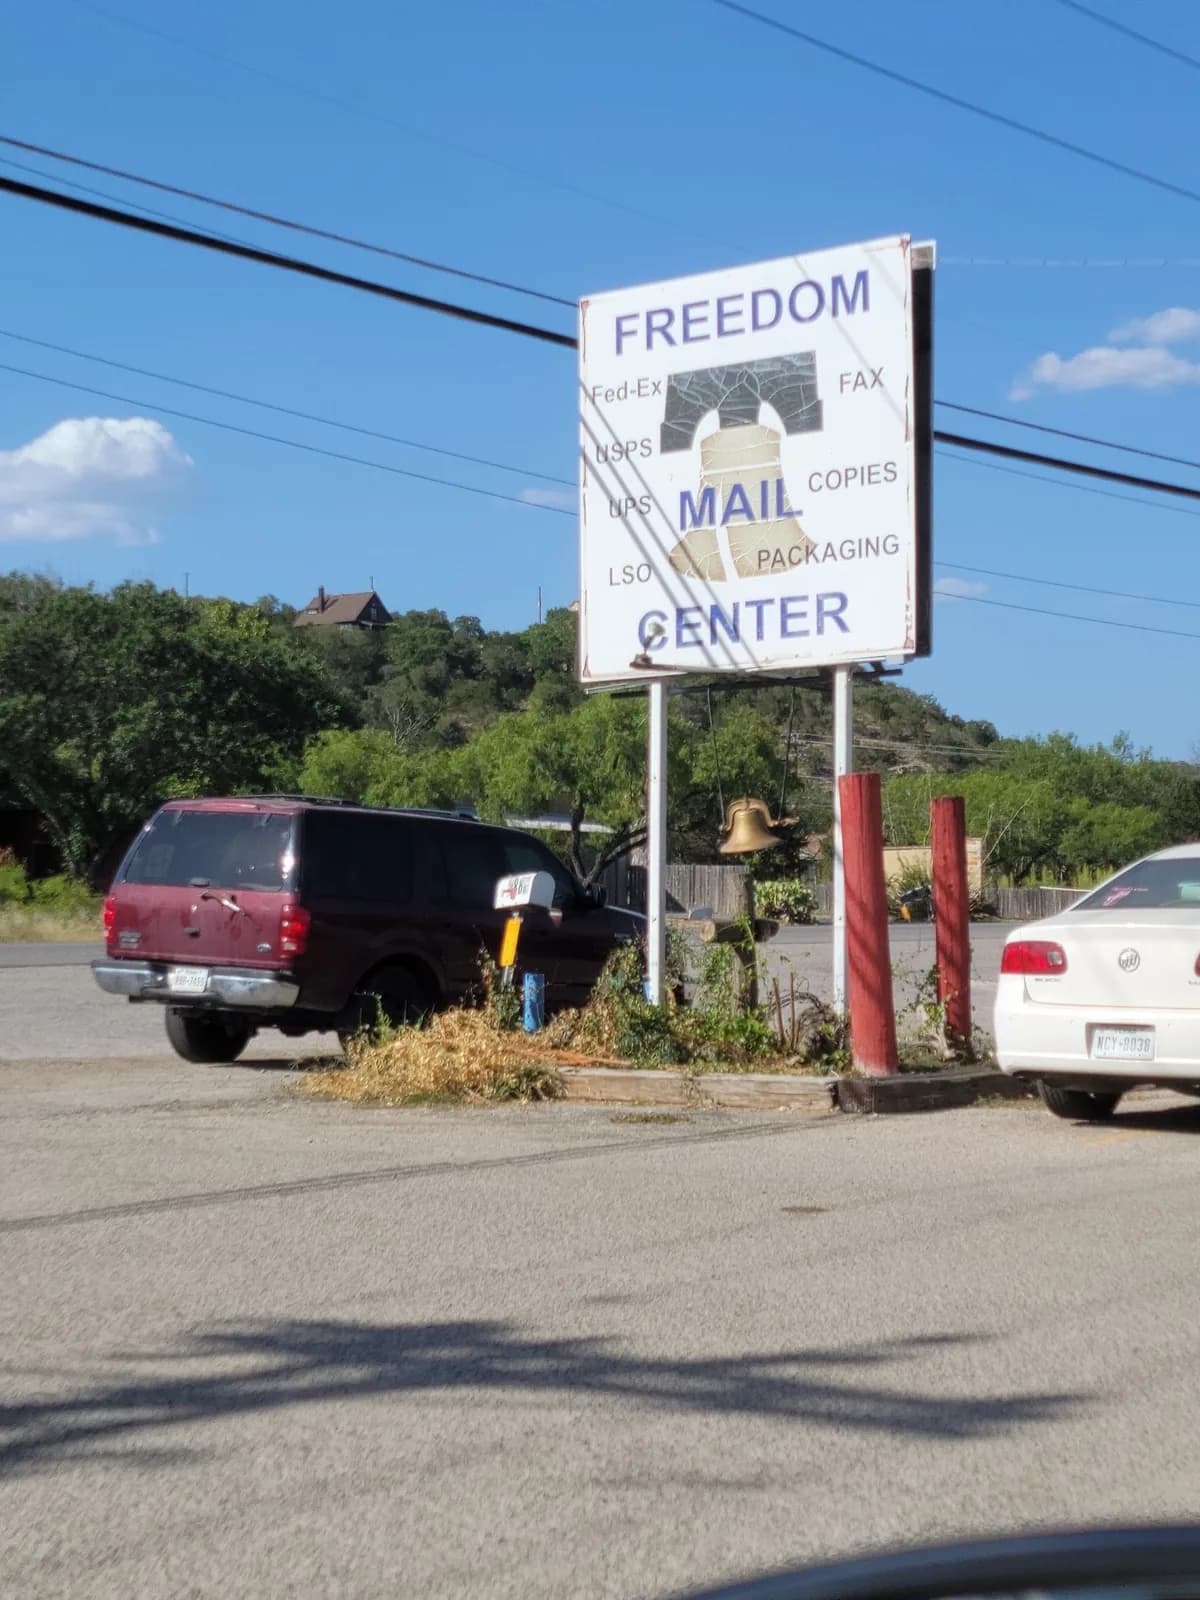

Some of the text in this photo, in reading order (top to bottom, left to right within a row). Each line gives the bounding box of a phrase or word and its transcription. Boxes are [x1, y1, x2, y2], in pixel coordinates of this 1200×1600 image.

[615, 269, 870, 356] FREEDOM
[592, 376, 663, 404] Fed-Ex
[839, 366, 885, 395] FAX
[595, 438, 653, 464] USPS
[808, 461, 898, 493] COPIES
[608, 495, 652, 519] UPS
[679, 477, 804, 532] MAIL
[757, 534, 900, 570] PACKAGING
[608, 562, 653, 587] LSO
[637, 591, 850, 651] CENTER
